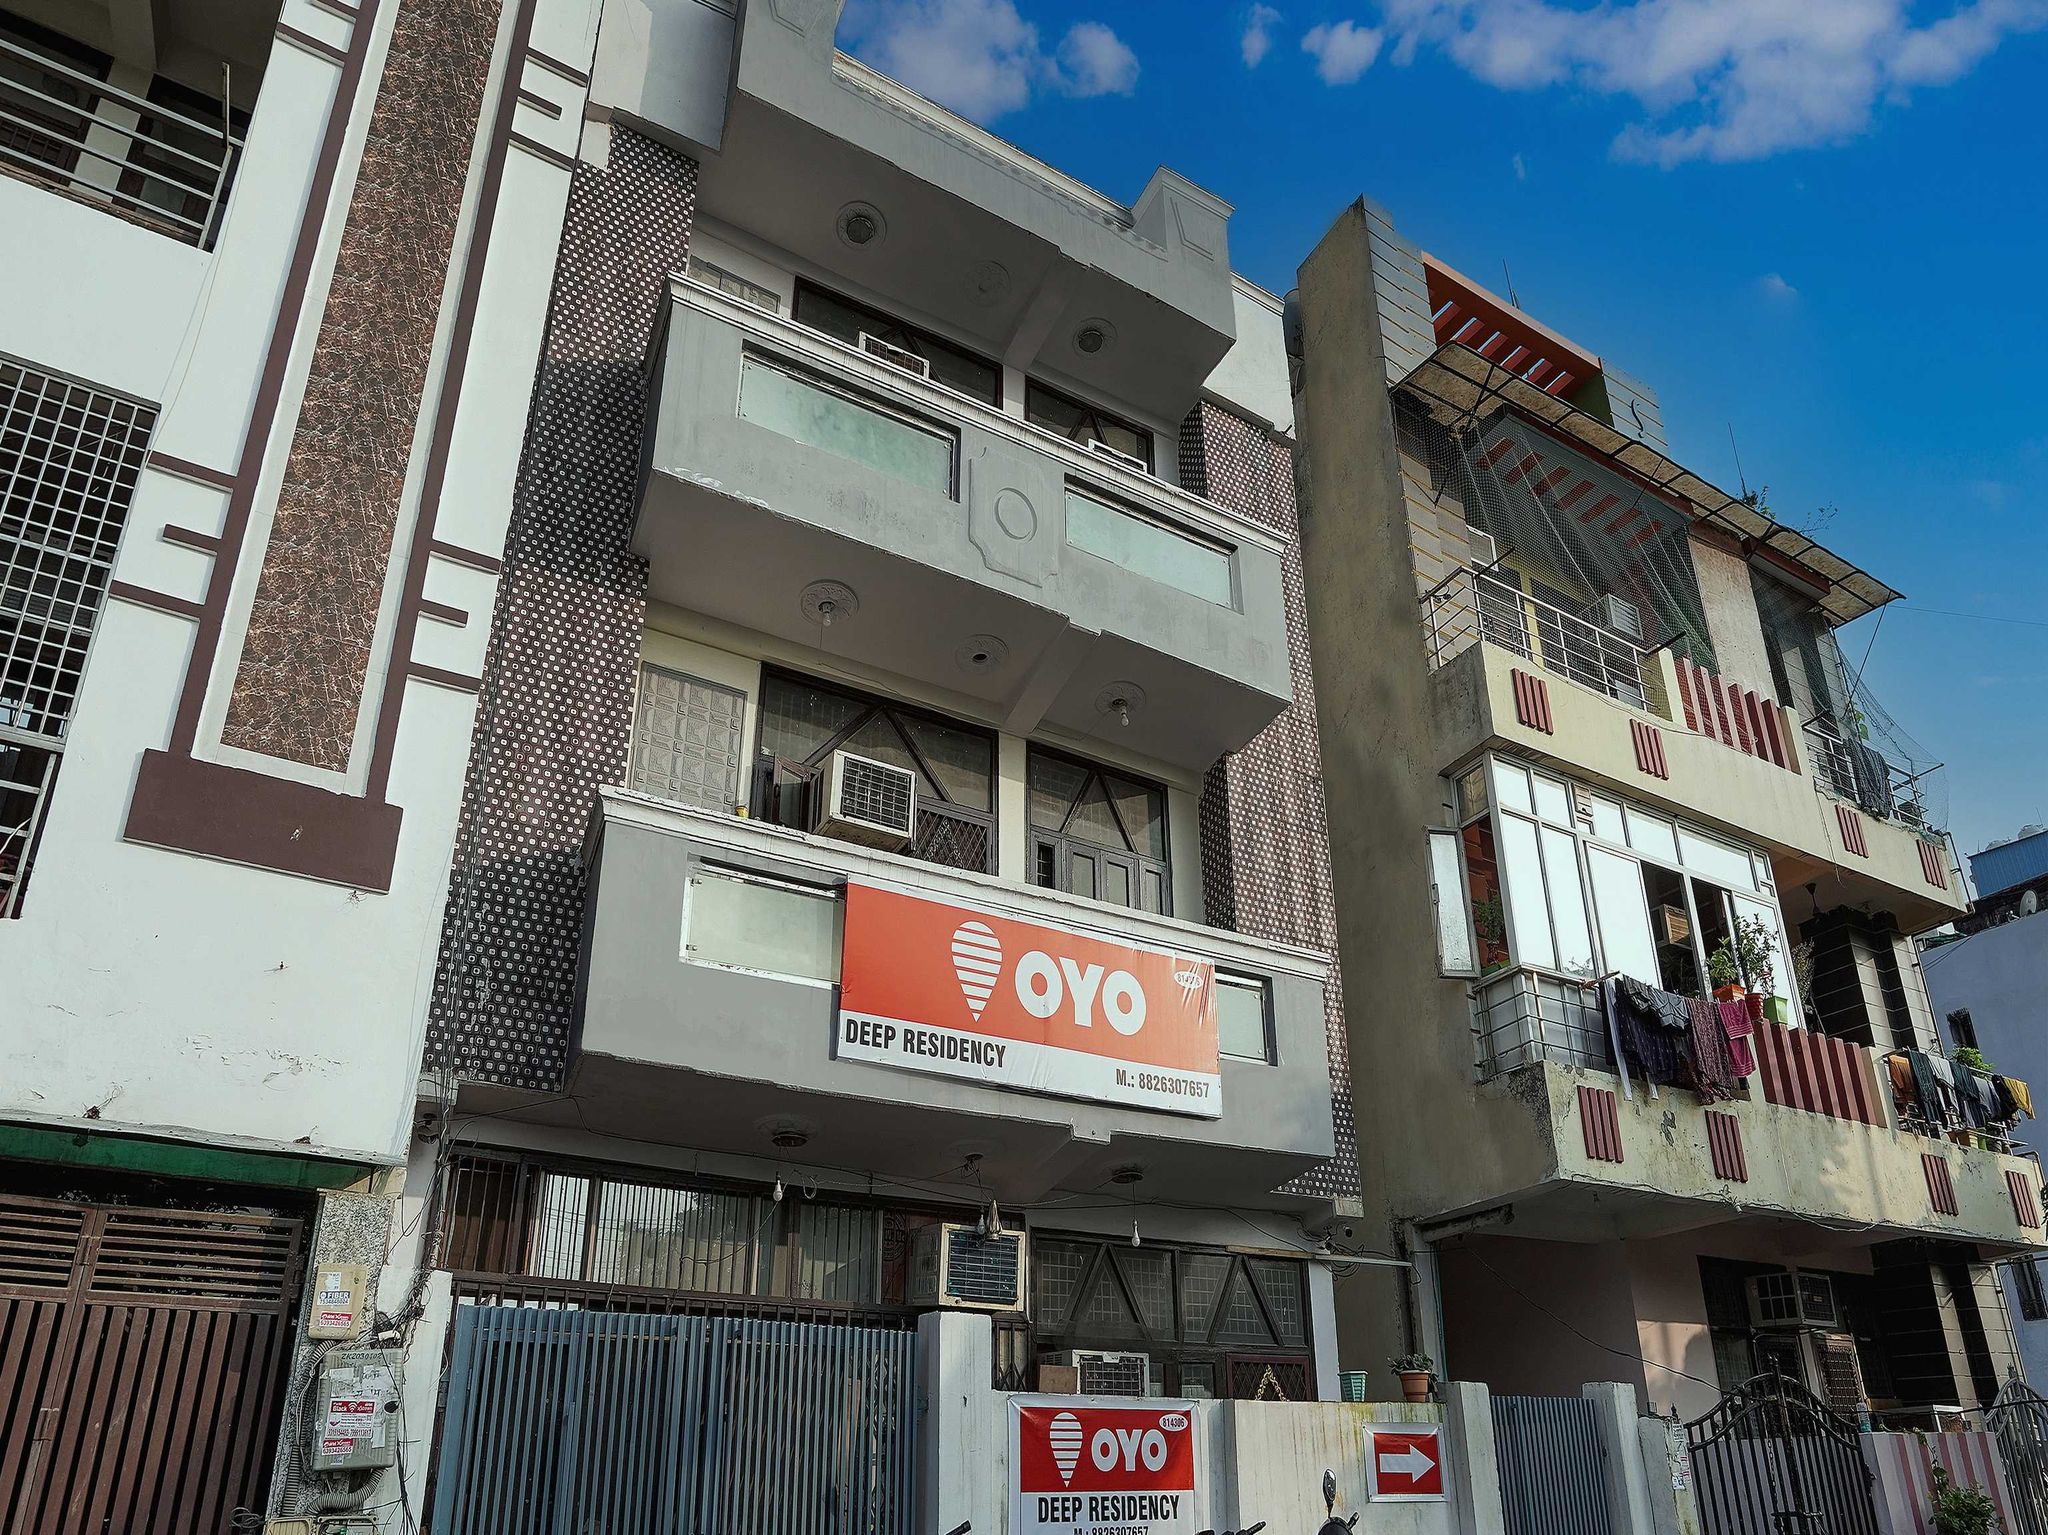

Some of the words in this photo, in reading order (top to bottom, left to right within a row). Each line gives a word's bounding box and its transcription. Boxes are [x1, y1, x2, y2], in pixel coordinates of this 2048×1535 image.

[1014, 950, 1147, 1036] OYO
[846, 1019, 896, 1049] DEEP
[903, 1028, 1007, 1068] RESIDENCY
[1116, 1068, 1135, 1088] M.:
[1139, 1072, 1210, 1098] 8826307657
[1091, 1428, 1167, 1472] OYO
[1038, 1497, 1082, 1523] DEEP
[1088, 1494, 1180, 1522] RESIDENCY
